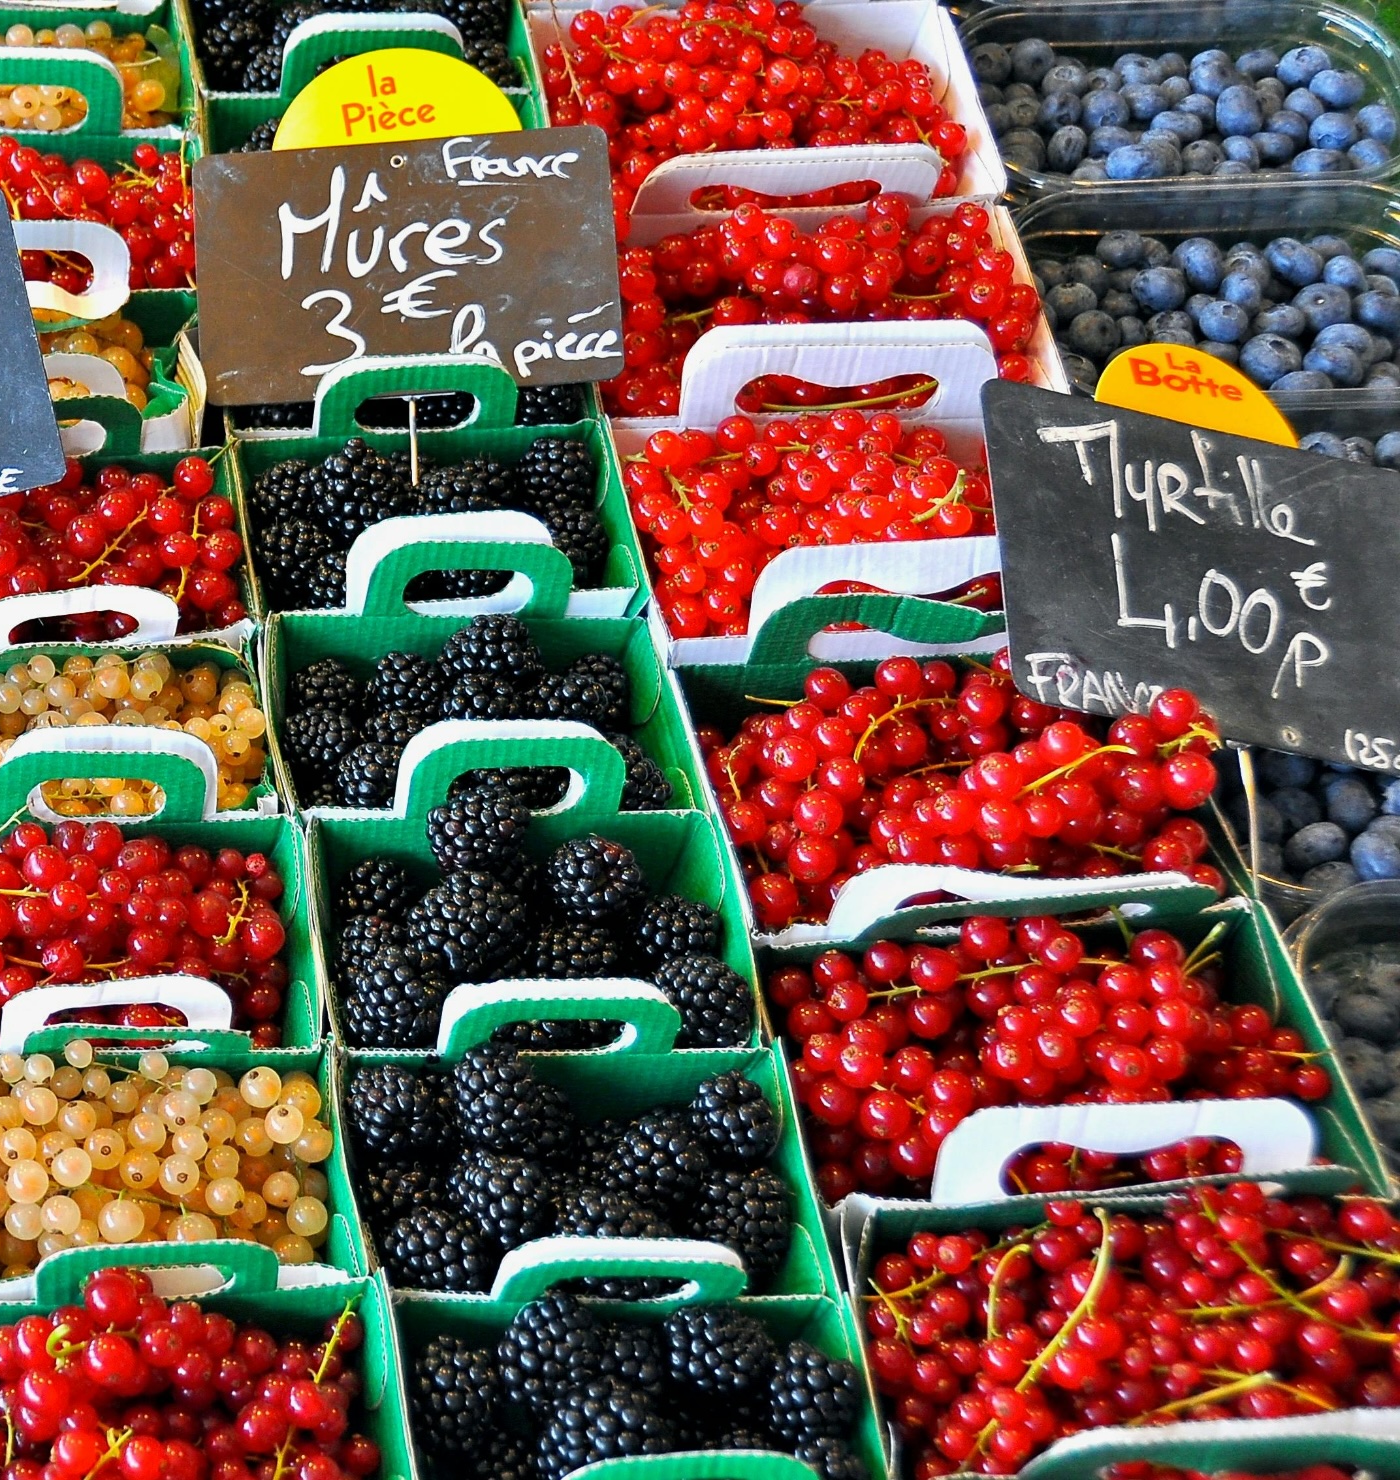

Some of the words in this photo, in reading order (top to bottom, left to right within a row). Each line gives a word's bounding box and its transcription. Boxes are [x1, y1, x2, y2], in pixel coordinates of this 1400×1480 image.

[367, 65, 397, 98] la
[340, 101, 436, 137] Pièce
[442, 137, 579, 180] France
[277, 165, 506, 280] Mûres
[1128, 357, 1243, 401] Botte
[1165, 352, 1202, 373] La
